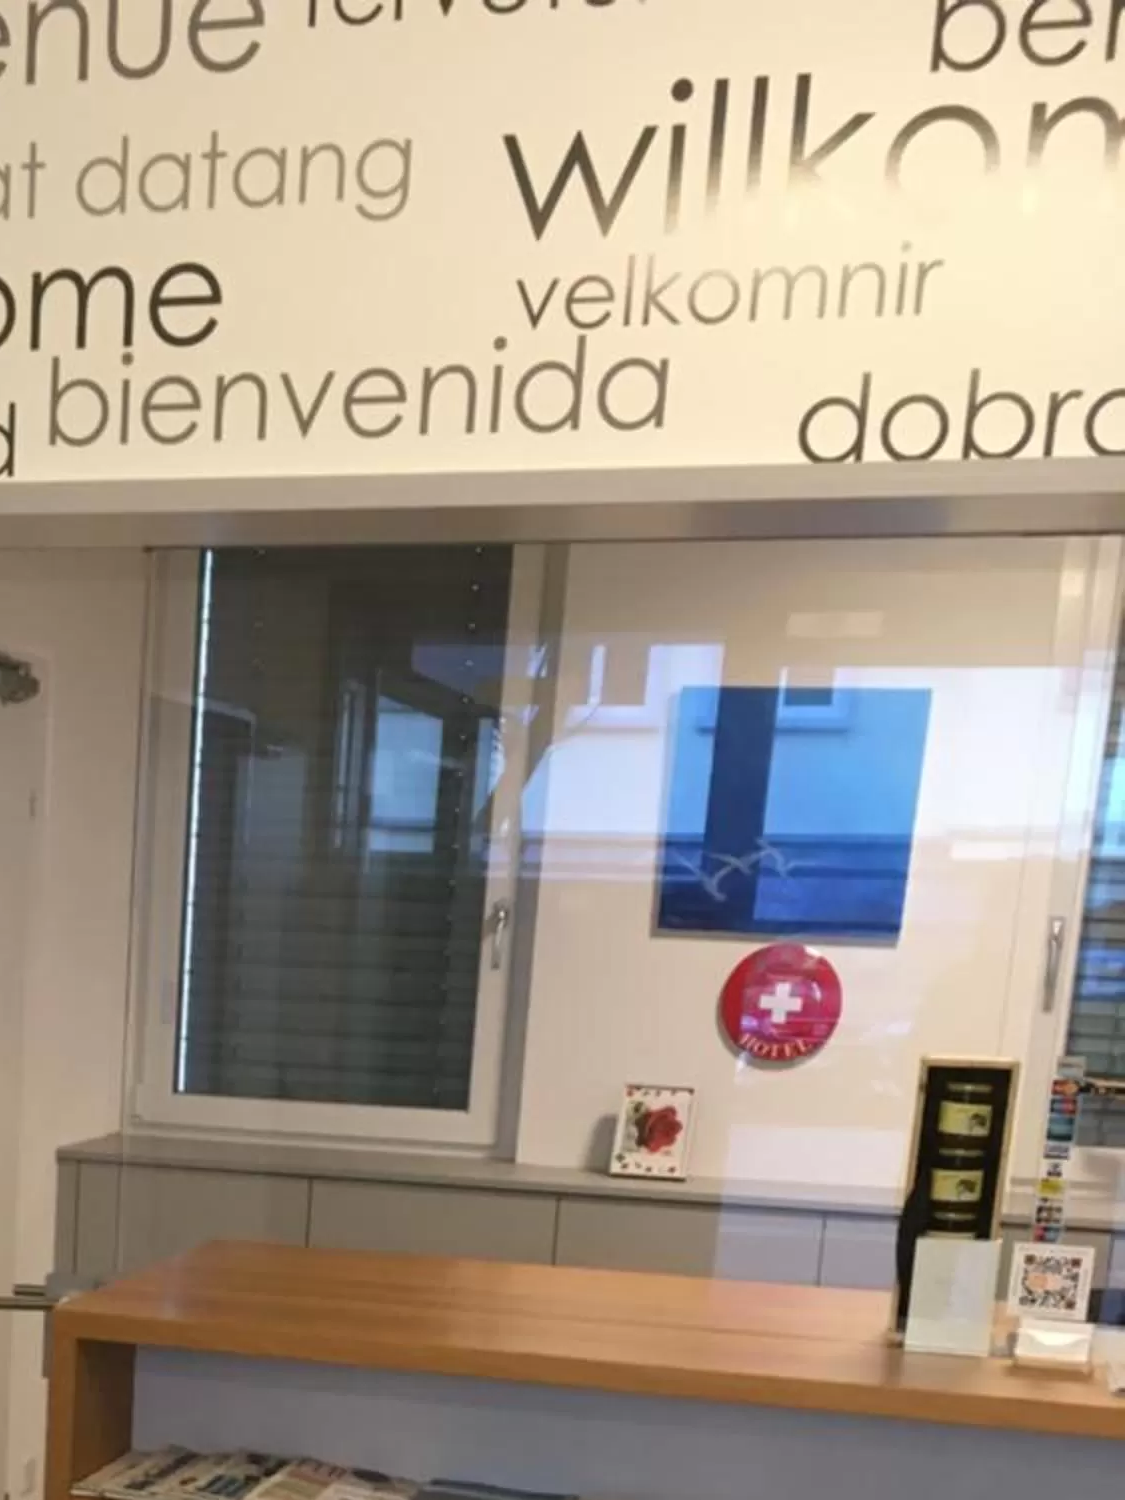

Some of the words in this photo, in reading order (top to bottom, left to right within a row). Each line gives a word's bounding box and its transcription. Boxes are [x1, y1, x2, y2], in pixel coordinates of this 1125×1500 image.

[76, 130, 412, 222] datang
[516, 240, 944, 330] velkomnir
[49, 334, 670, 448] bienvenida
